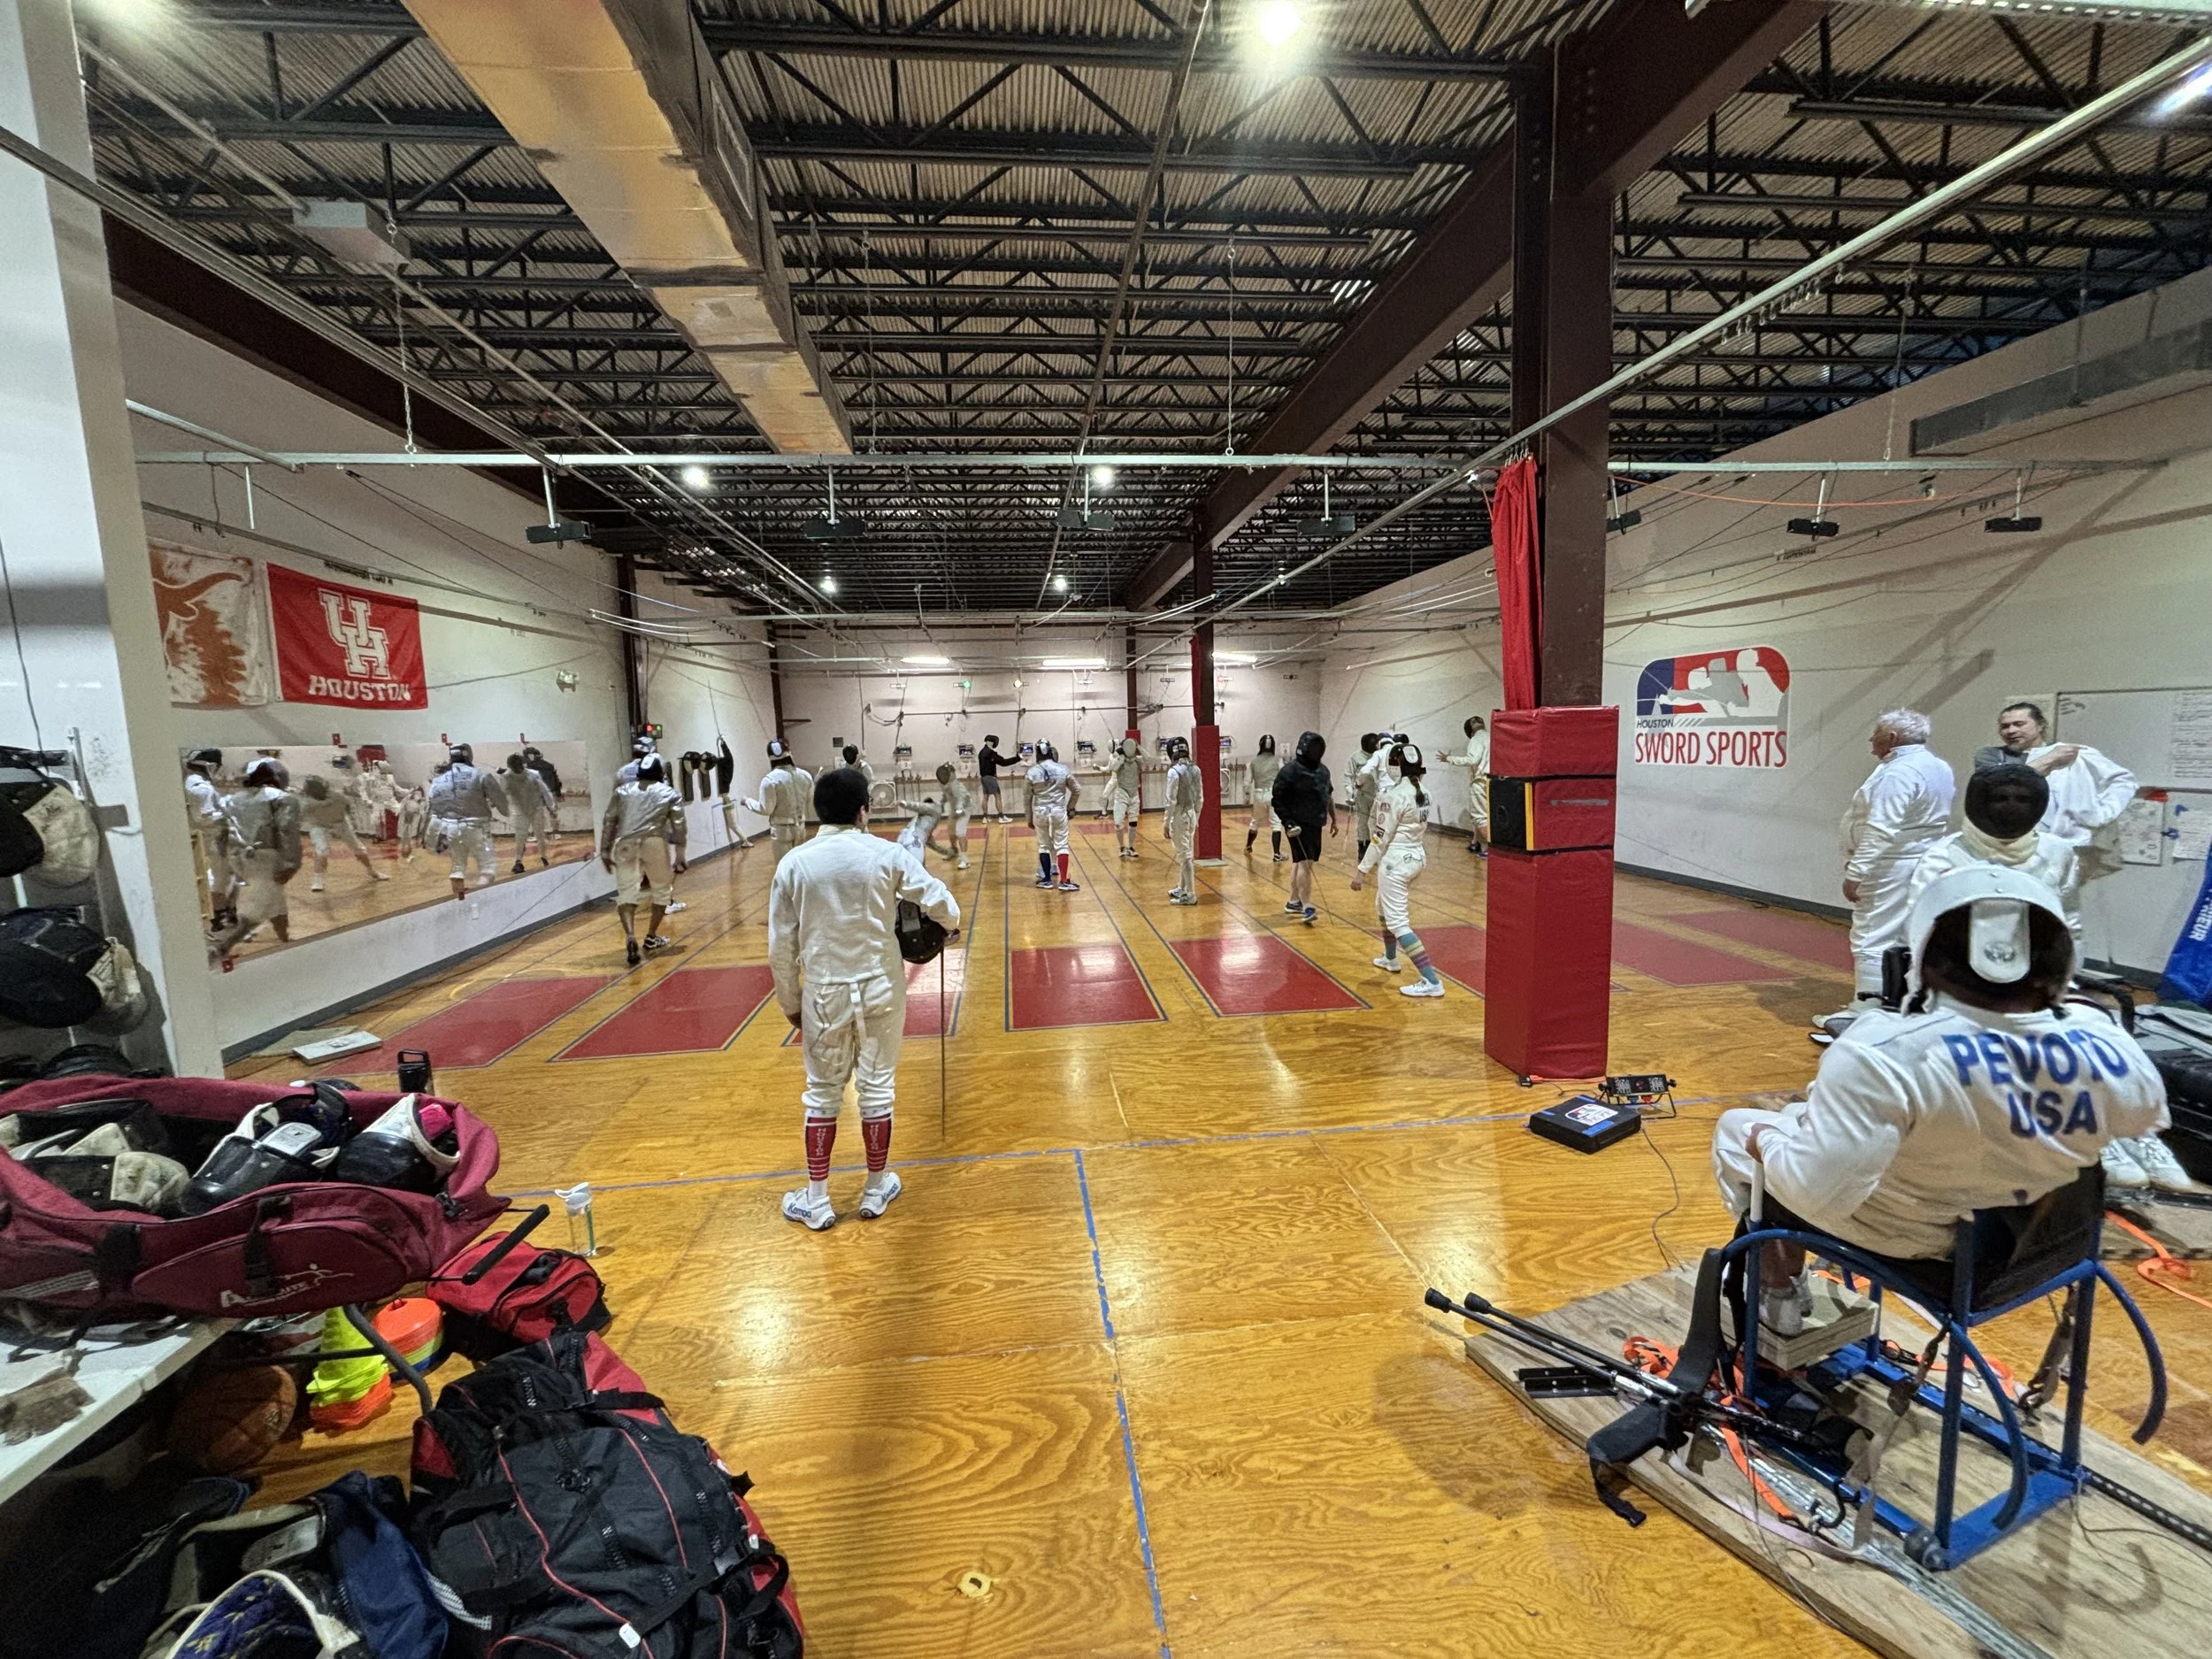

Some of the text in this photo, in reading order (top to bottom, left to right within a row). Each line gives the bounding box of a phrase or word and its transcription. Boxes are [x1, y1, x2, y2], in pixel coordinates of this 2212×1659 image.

[308, 675, 411, 702] HOUSTON
[1637, 718, 1674, 728] HOUSTON
[1635, 731, 1787, 767] SWORD SPORTS
[1941, 1029, 2129, 1086] PEVOTO
[2007, 1090, 2098, 1138] USA
[787, 1203, 811, 1218] Kempa
